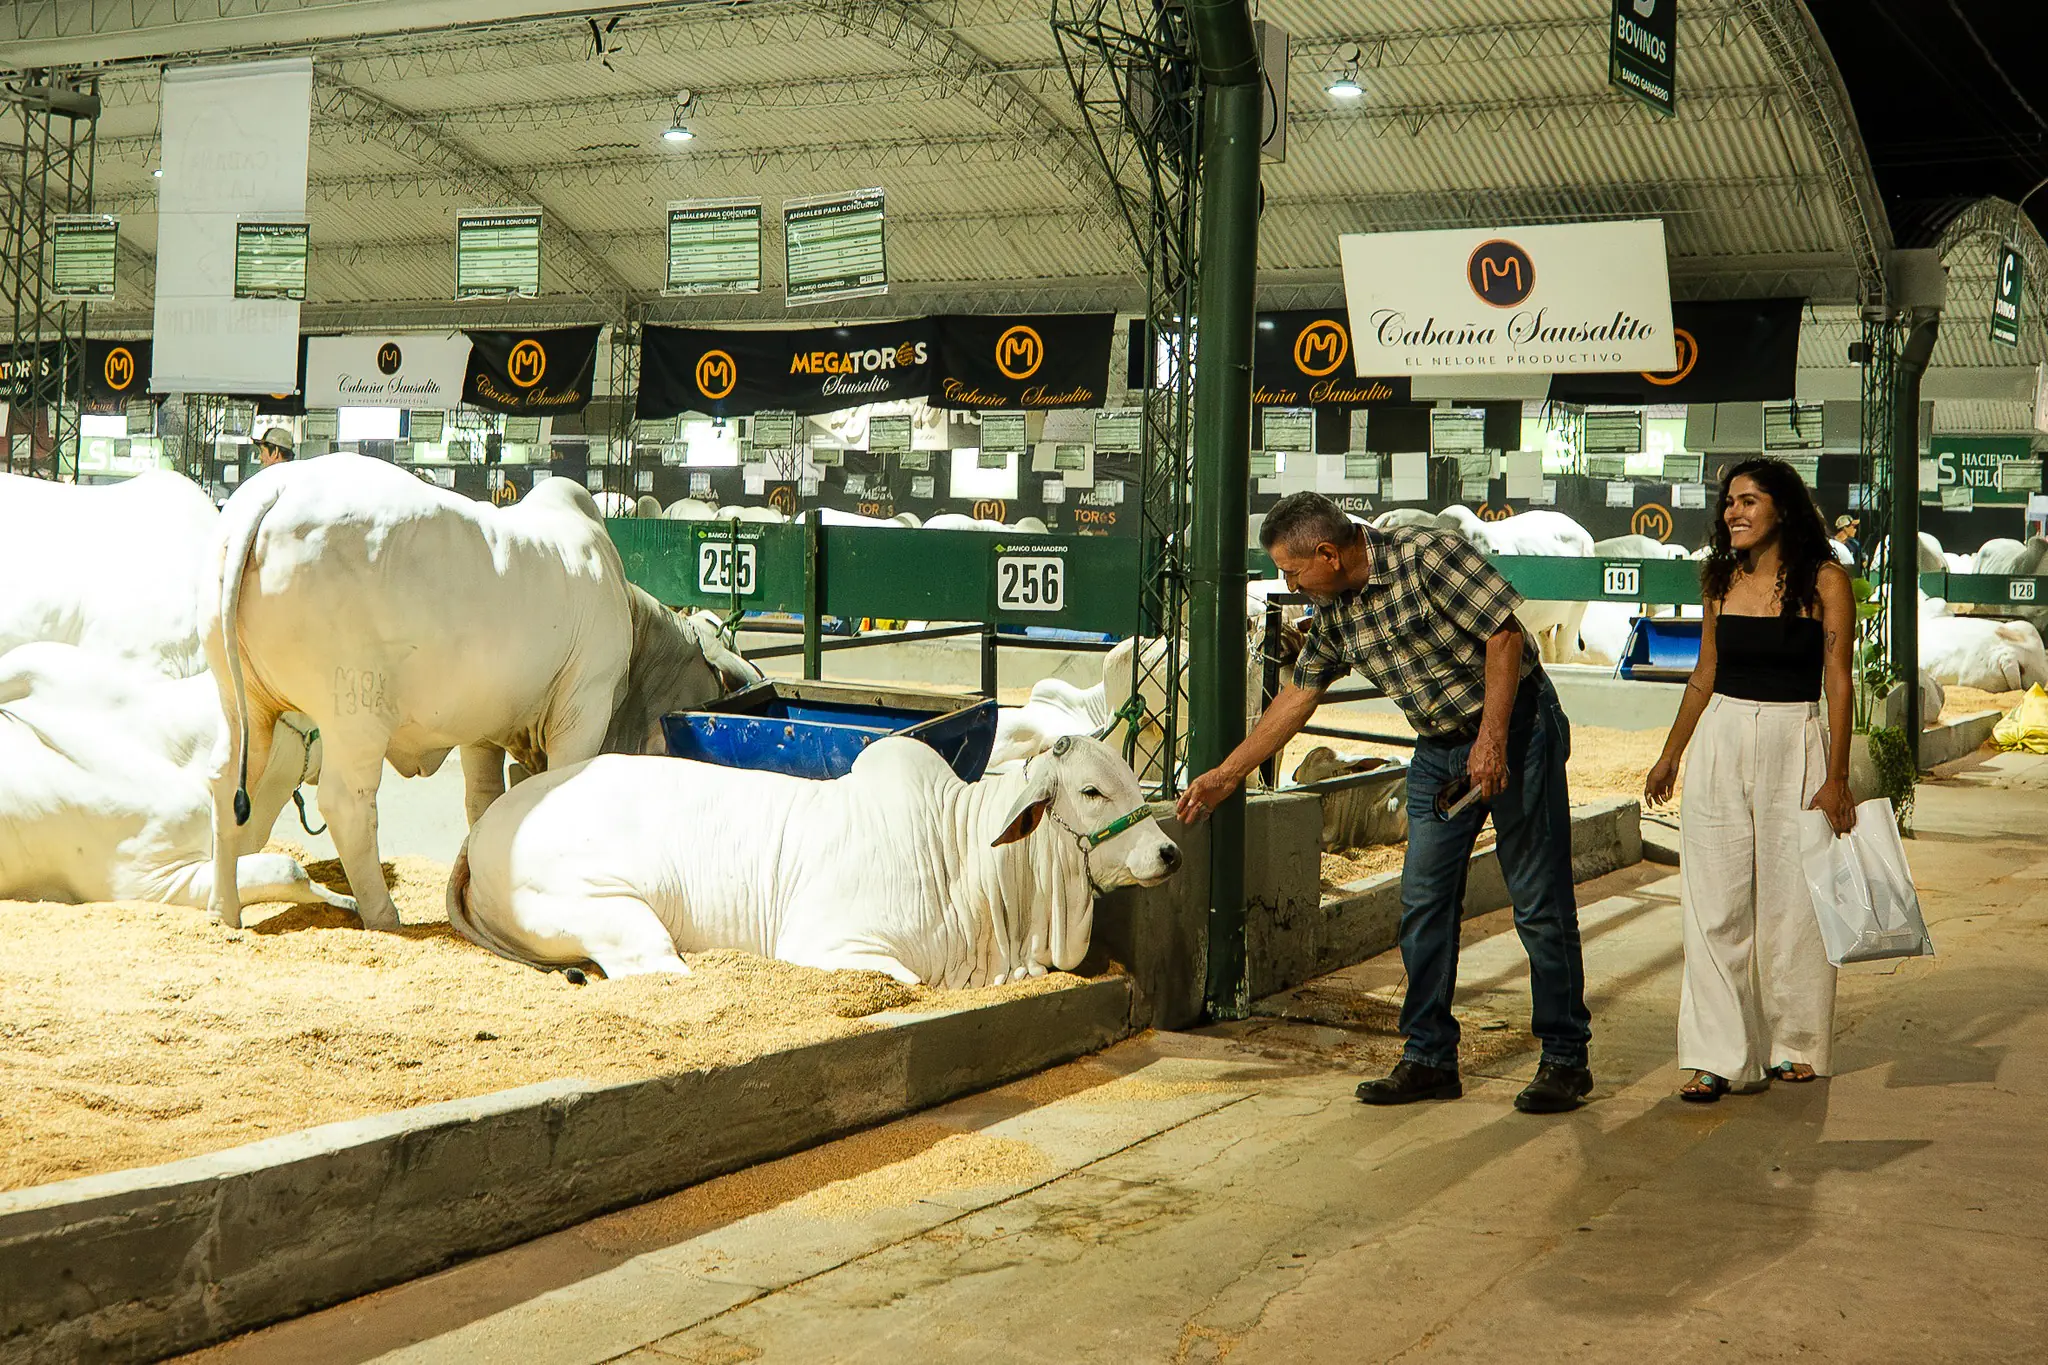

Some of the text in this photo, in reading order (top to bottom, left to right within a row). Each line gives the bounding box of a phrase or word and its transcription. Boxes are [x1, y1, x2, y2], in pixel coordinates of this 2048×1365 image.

[1618, 14, 1666, 64] BOVINOS
[672, 212, 703, 221] ANIMALES
[704, 211, 721, 220] PARA
[789, 200, 879, 220] ANIMALES PARA CONCURSO
[461, 218, 537, 228] ANIMALES PARA CONCURSO
[2002, 253, 2014, 297] C
[1370, 307, 1656, 352] Cabaña Sausalito
[1405, 352, 1623, 367] EL NELORE PRODUCTIVO
[822, 372, 892, 397] Sausalito
[1020, 383, 1095, 407] Sausalito
[1309, 378, 1394, 407] Sausalito
[1938, 452, 1956, 485] S
[1334, 497, 1374, 512] MEGA
[707, 532, 728, 540] BANCO
[1031, 545, 1068, 553] GANADERO
[703, 548, 751, 588] 255
[1002, 563, 1059, 605] 256
[1608, 571, 1634, 591] 191
[2012, 584, 2033, 598] 128
